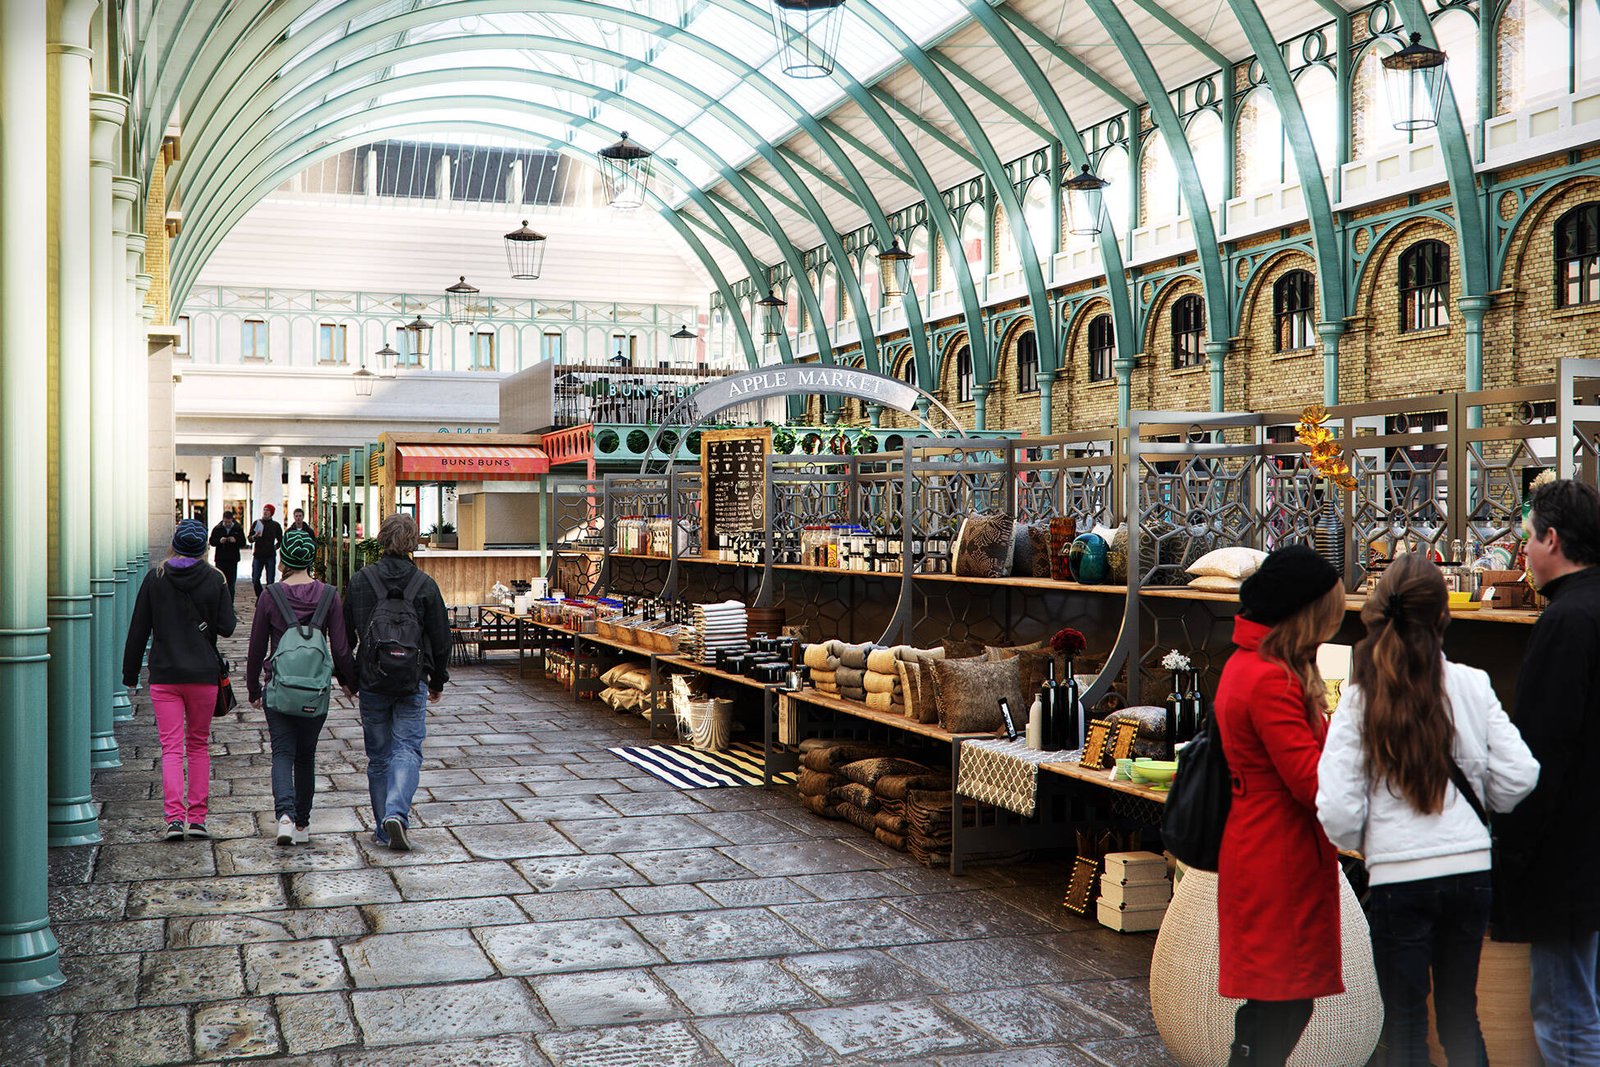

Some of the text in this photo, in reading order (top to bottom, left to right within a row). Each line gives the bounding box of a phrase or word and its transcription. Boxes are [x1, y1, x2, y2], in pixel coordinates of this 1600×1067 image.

[608, 383, 660, 399] BUNS
[728, 370, 884, 398] APPLE MARKET
[441, 458, 511, 467] BUNS BUNS
